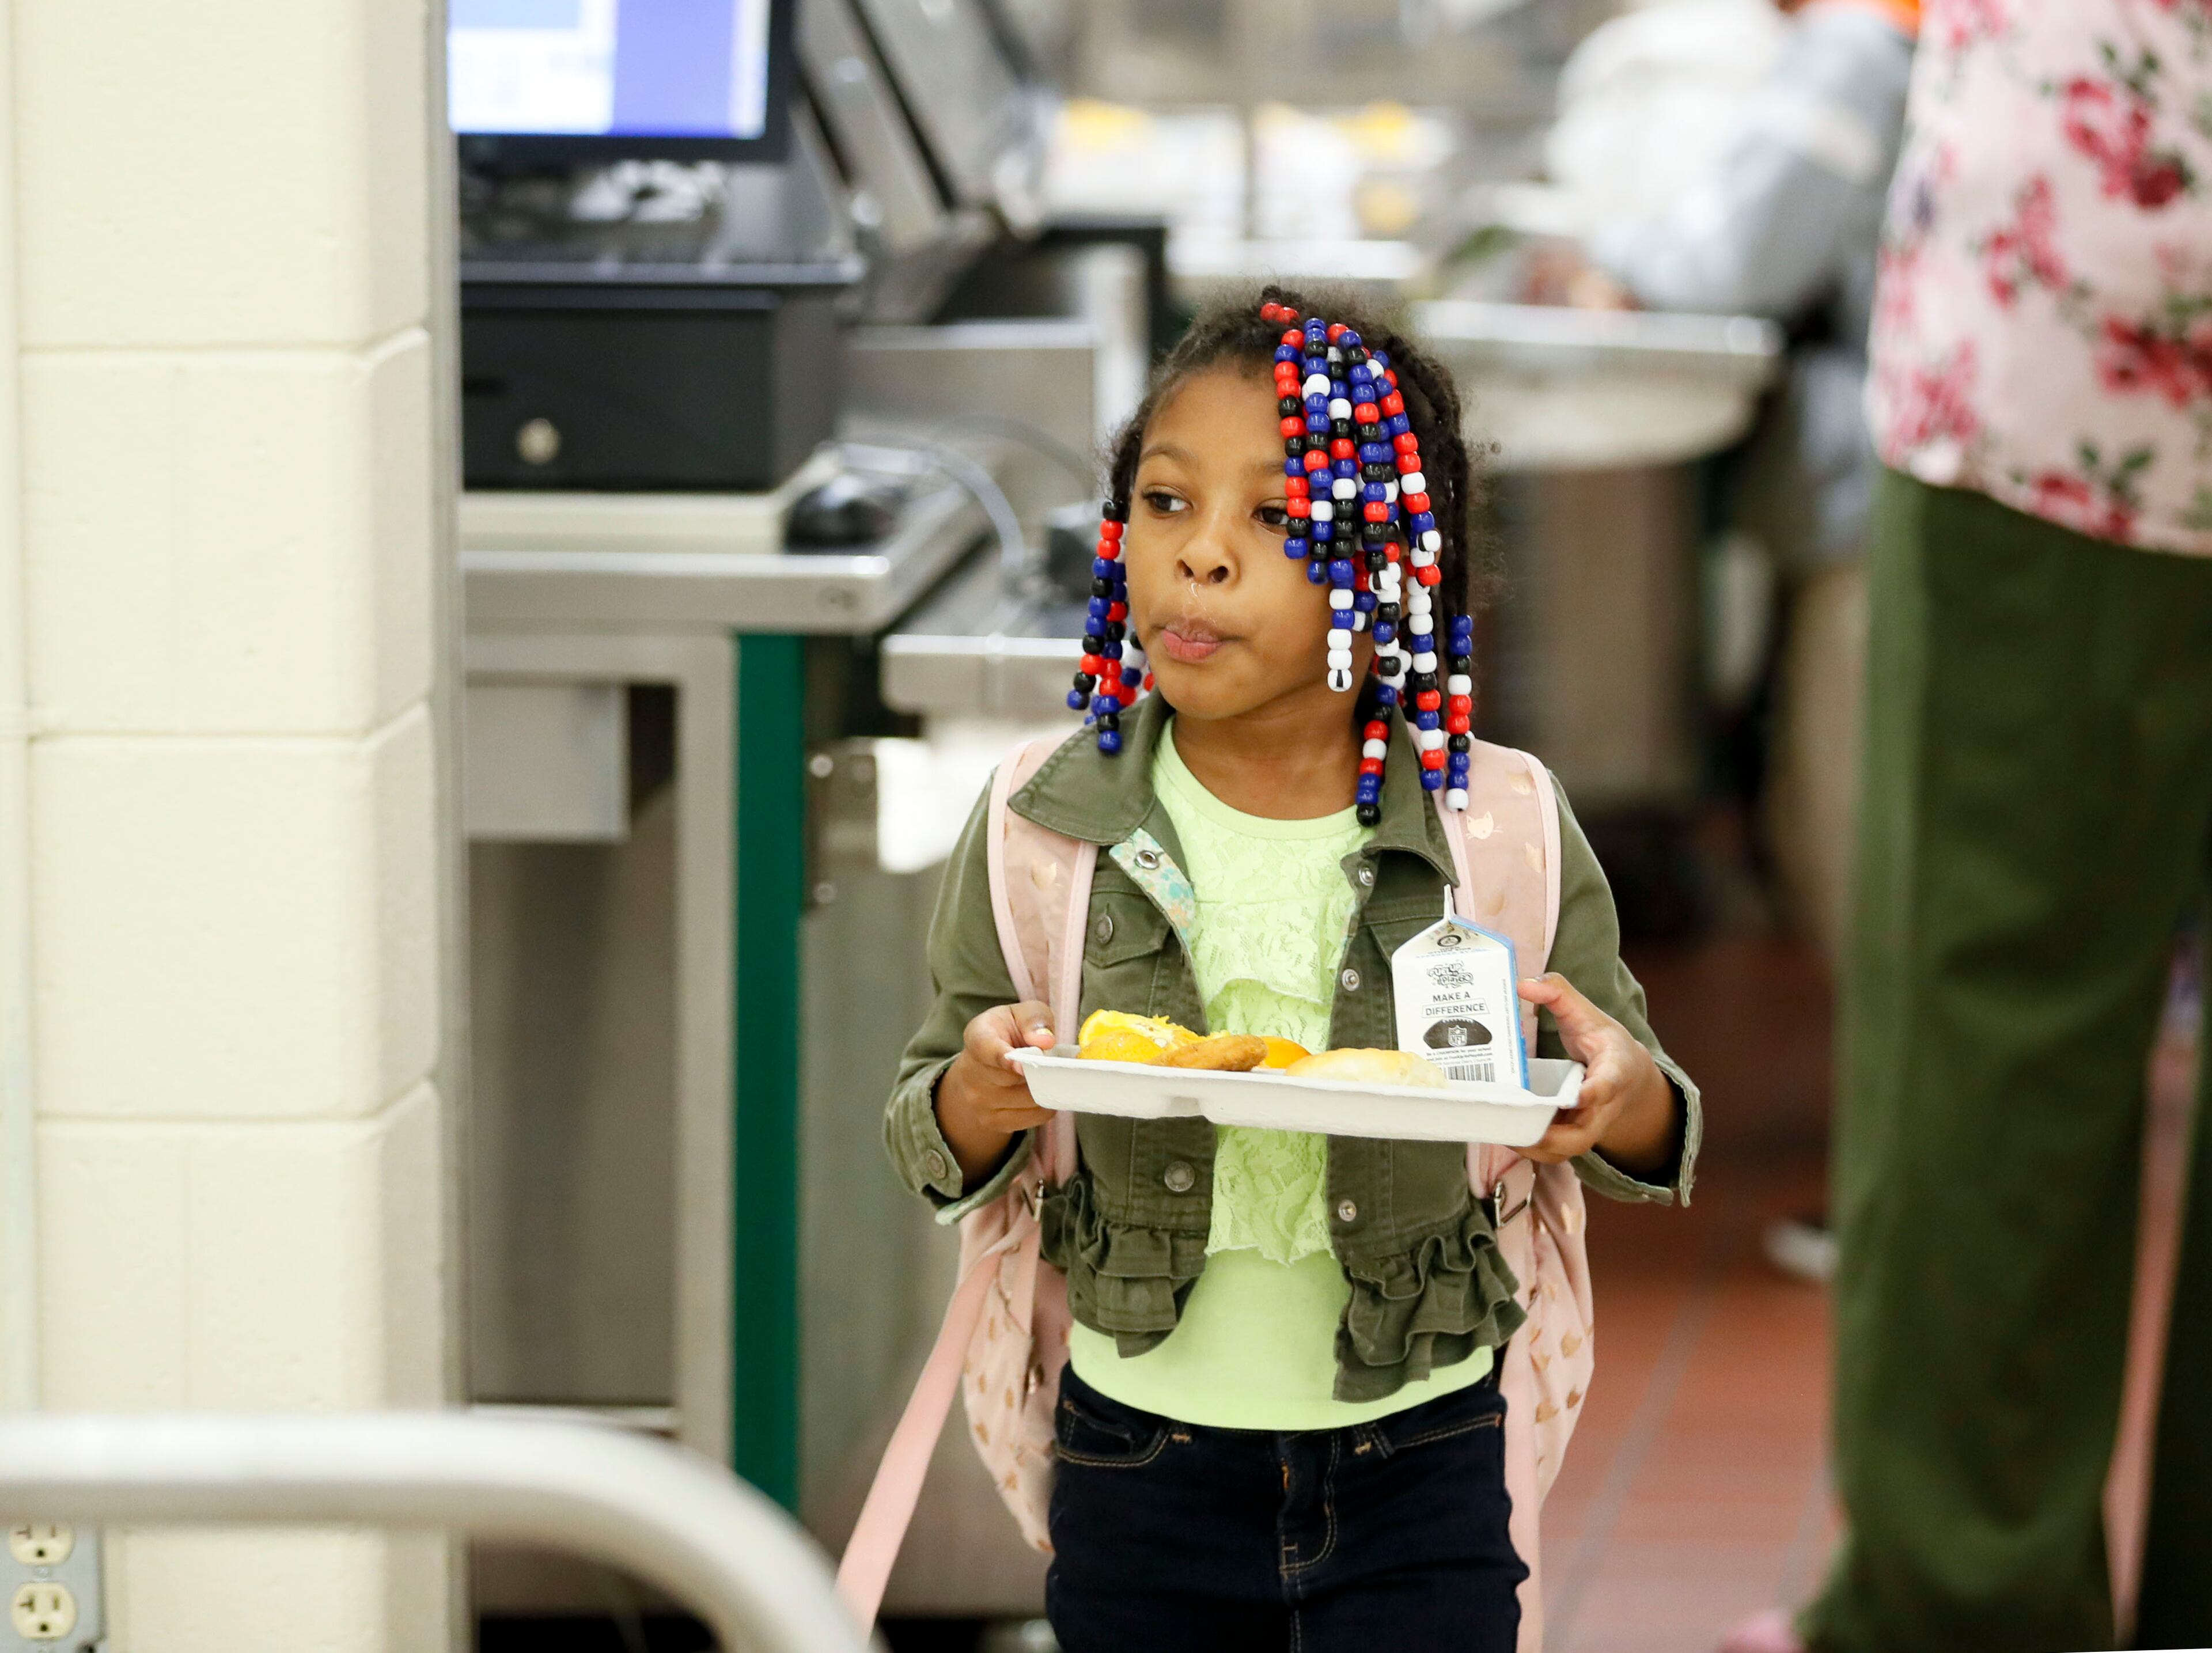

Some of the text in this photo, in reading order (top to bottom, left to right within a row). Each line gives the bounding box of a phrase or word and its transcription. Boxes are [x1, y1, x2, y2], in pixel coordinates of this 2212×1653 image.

[1433, 992, 1461, 1002] MAKE
[1425, 1003, 1485, 1015] DIFFERENCE
[1451, 1034, 1465, 1043] NFL
